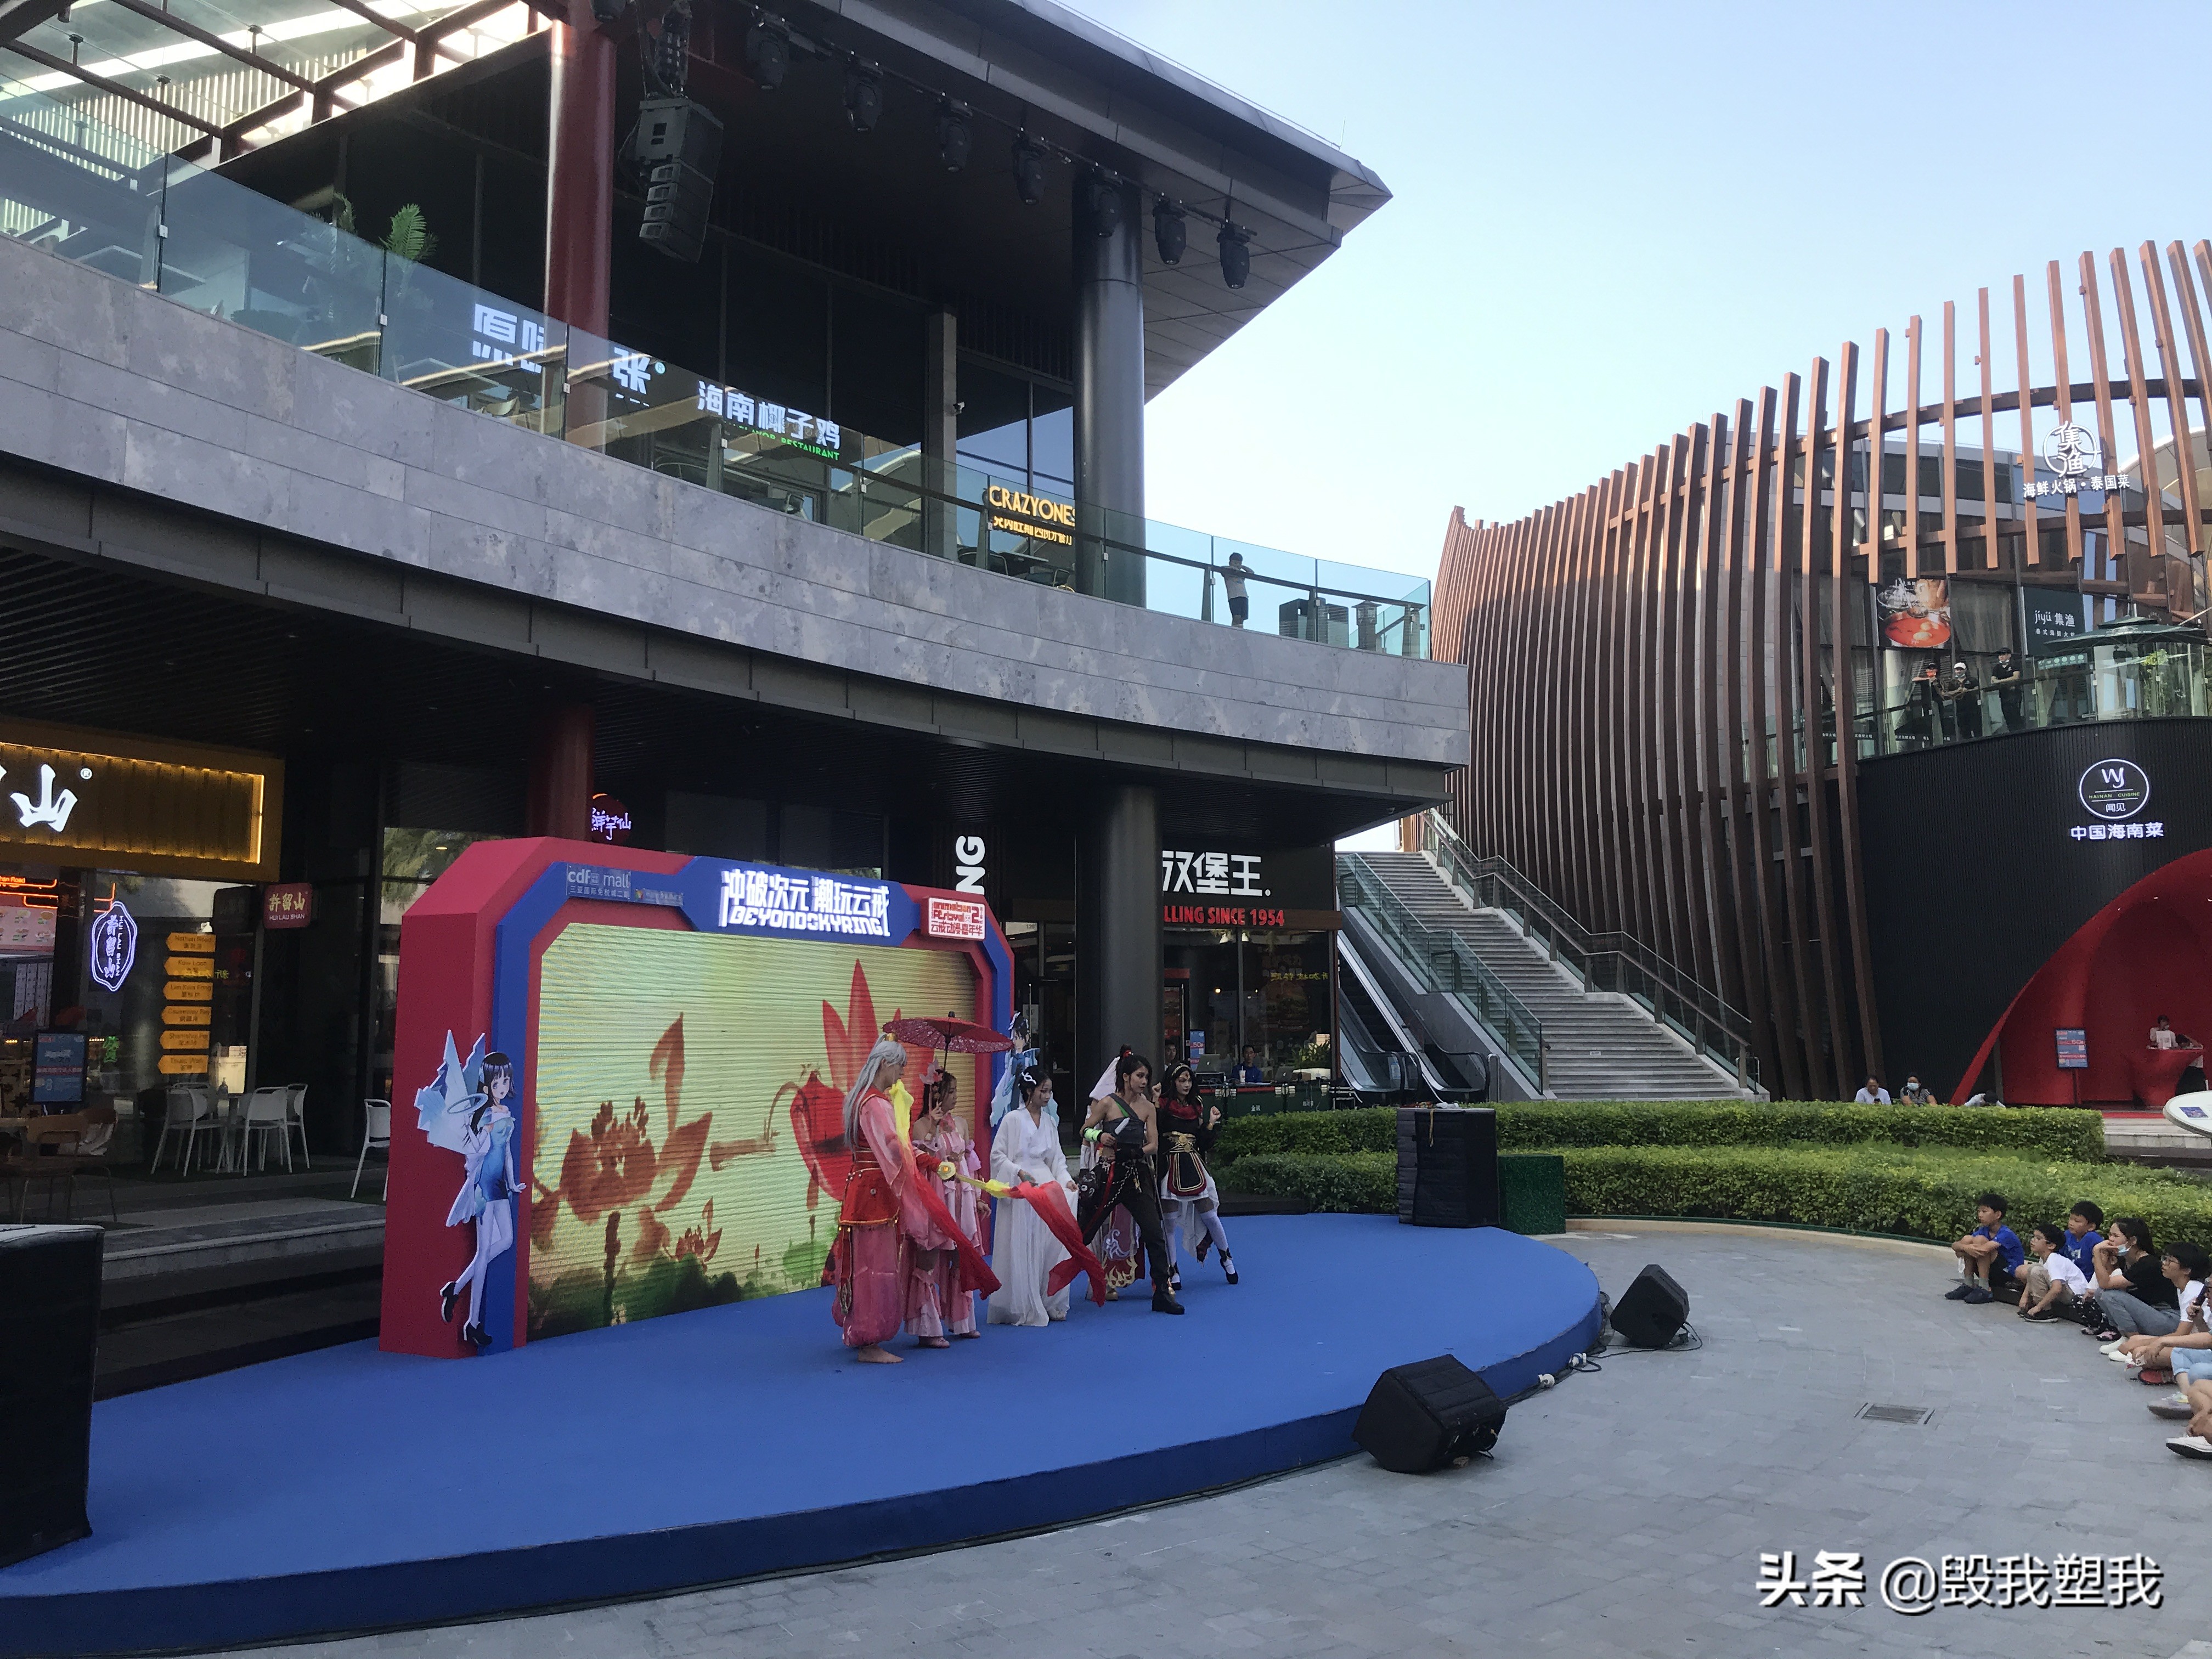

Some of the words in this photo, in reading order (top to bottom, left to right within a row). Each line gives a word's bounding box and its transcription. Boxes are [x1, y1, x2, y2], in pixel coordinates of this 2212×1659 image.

[698, 381, 840, 449] 海南椰子鸡
[0, 764, 78, 832] 山
[2070, 822, 2164, 841] 中国海南菜
[568, 868, 591, 884] cdf
[603, 873, 630, 888] mall
[719, 868, 809, 927] 冲破次元
[1207, 907, 1245, 926] SINCE
[1250, 909, 1285, 927] 1954
